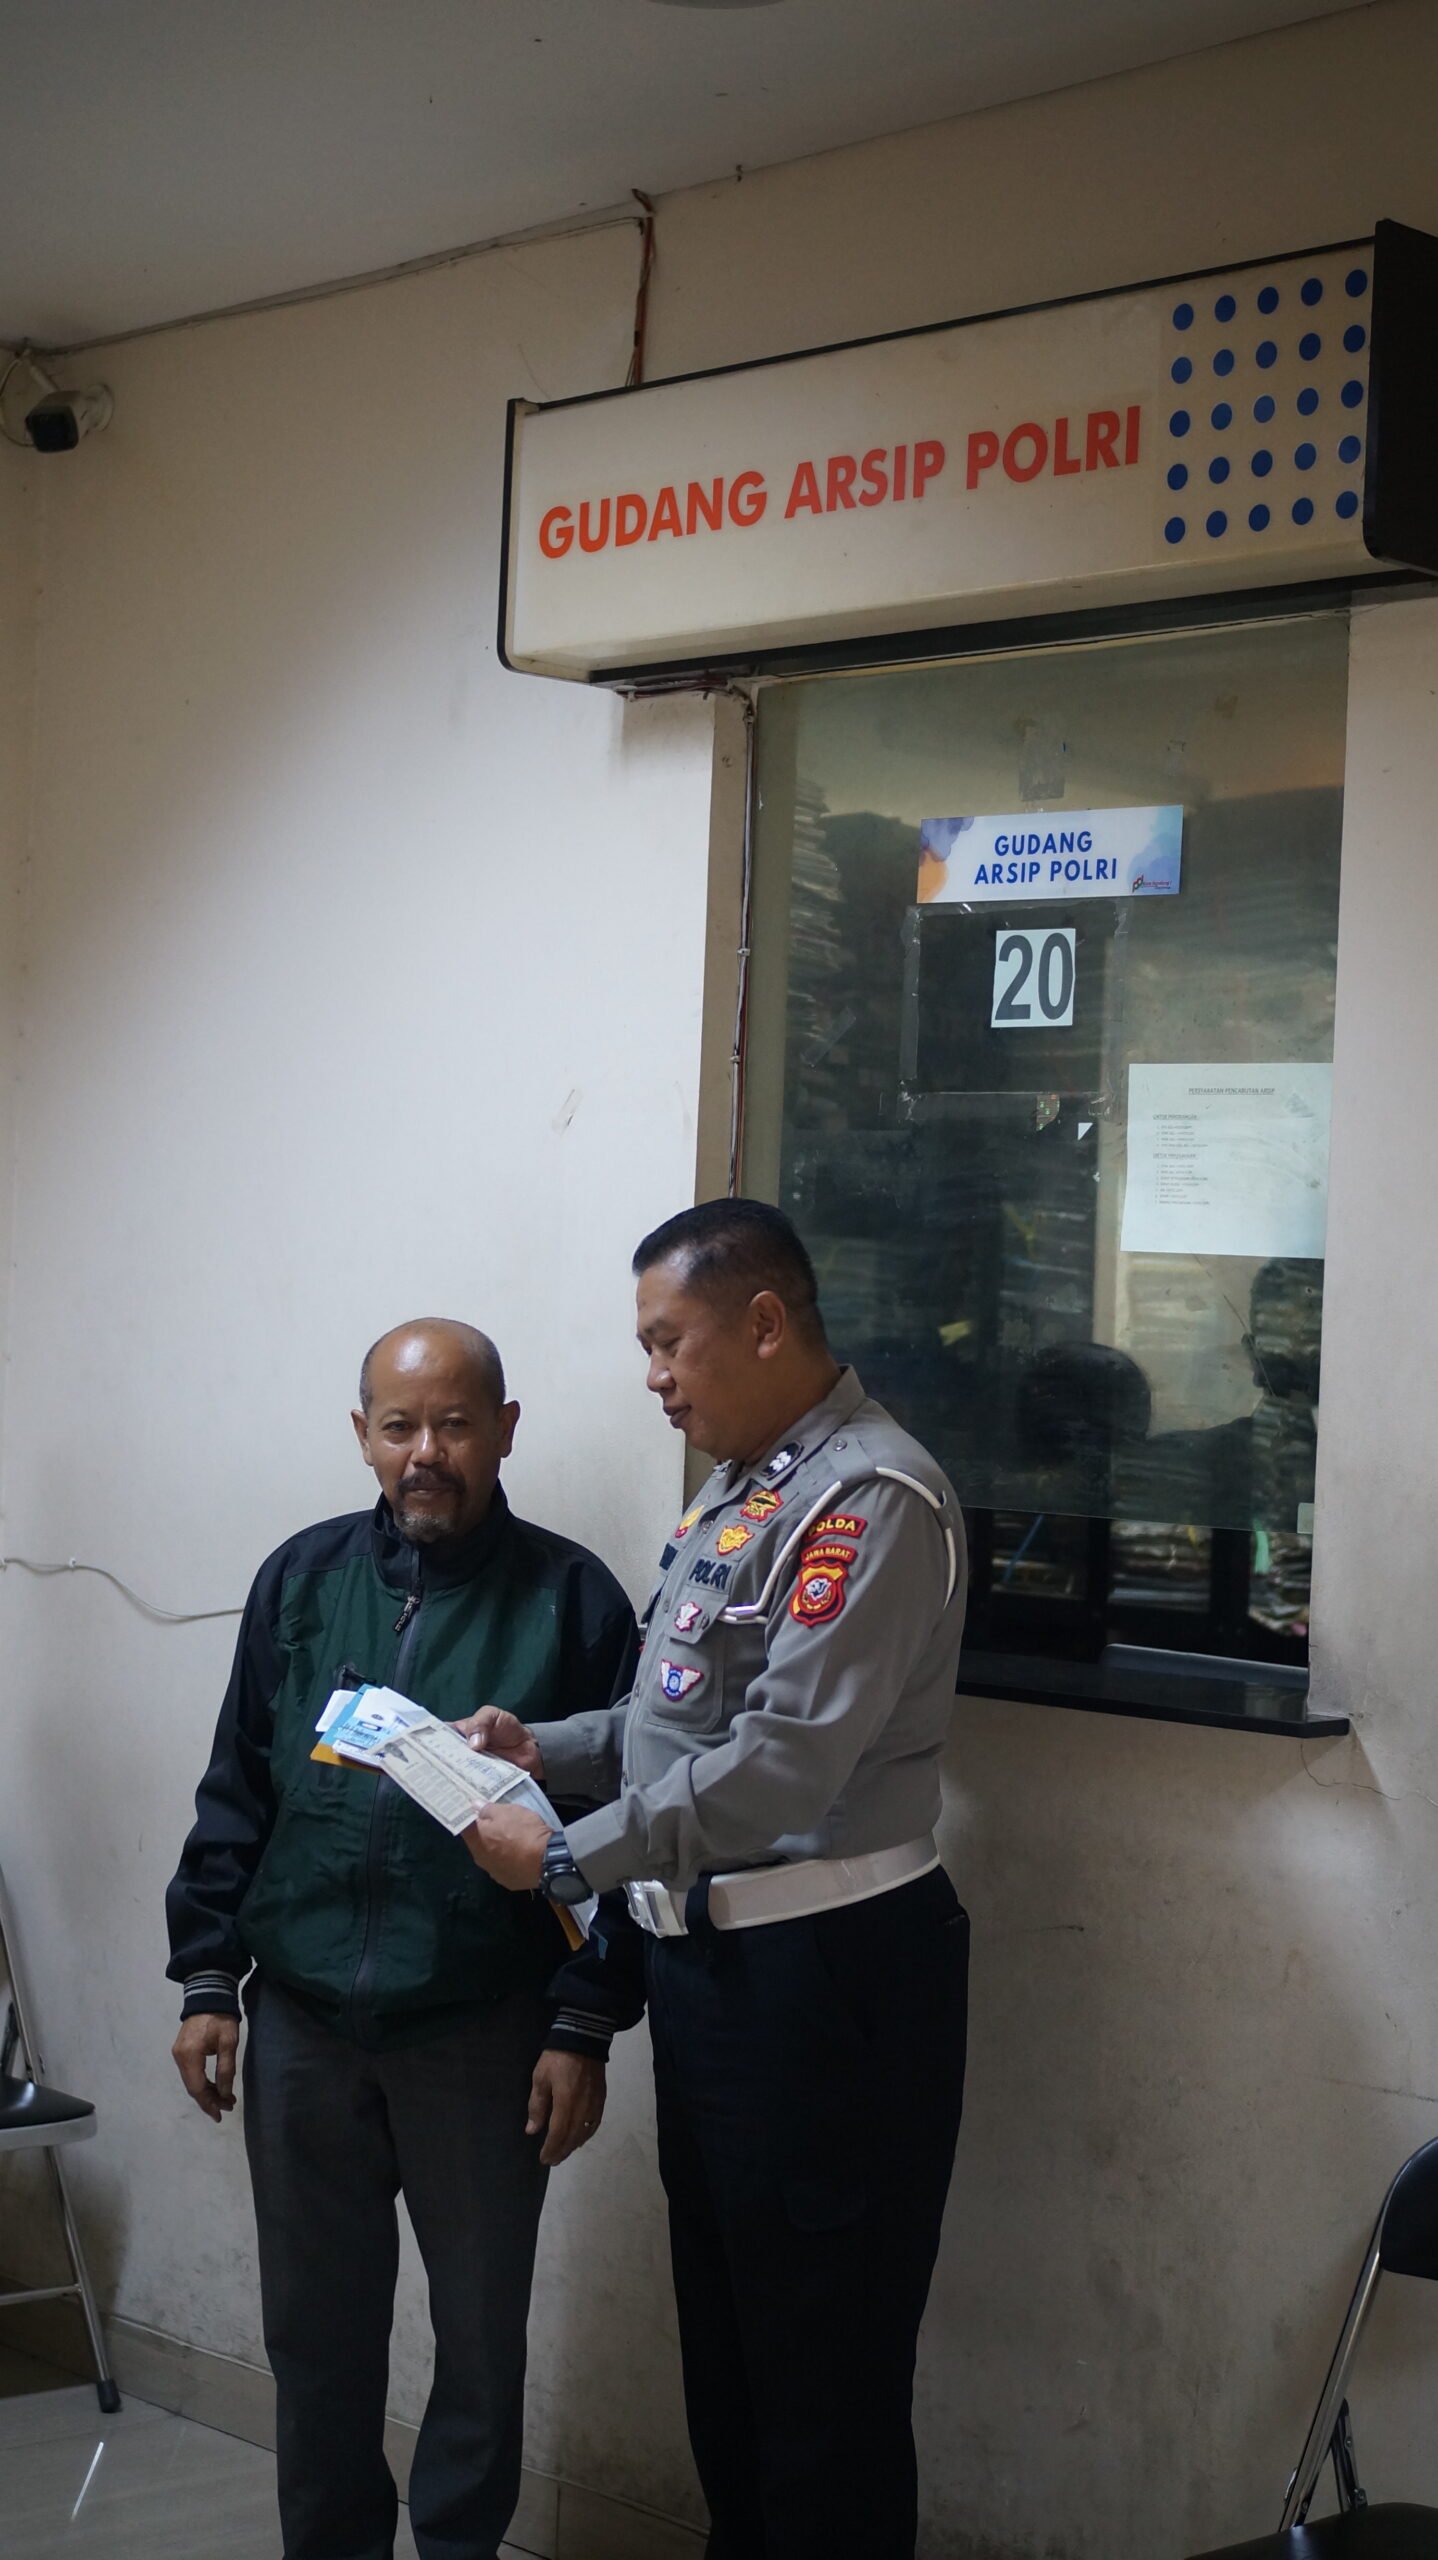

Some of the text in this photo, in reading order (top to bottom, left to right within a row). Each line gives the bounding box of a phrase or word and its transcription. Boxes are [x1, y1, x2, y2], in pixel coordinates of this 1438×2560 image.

[538, 405, 1141, 559] GUDANG ARSIP POLRI
[994, 831, 1093, 857] GUDANG
[974, 858, 1117, 885] ARSIP POLRI
[994, 932, 1074, 1020] 20
[825, 1547, 851, 1558] BARAT
[689, 1559, 731, 1590] POLRI
